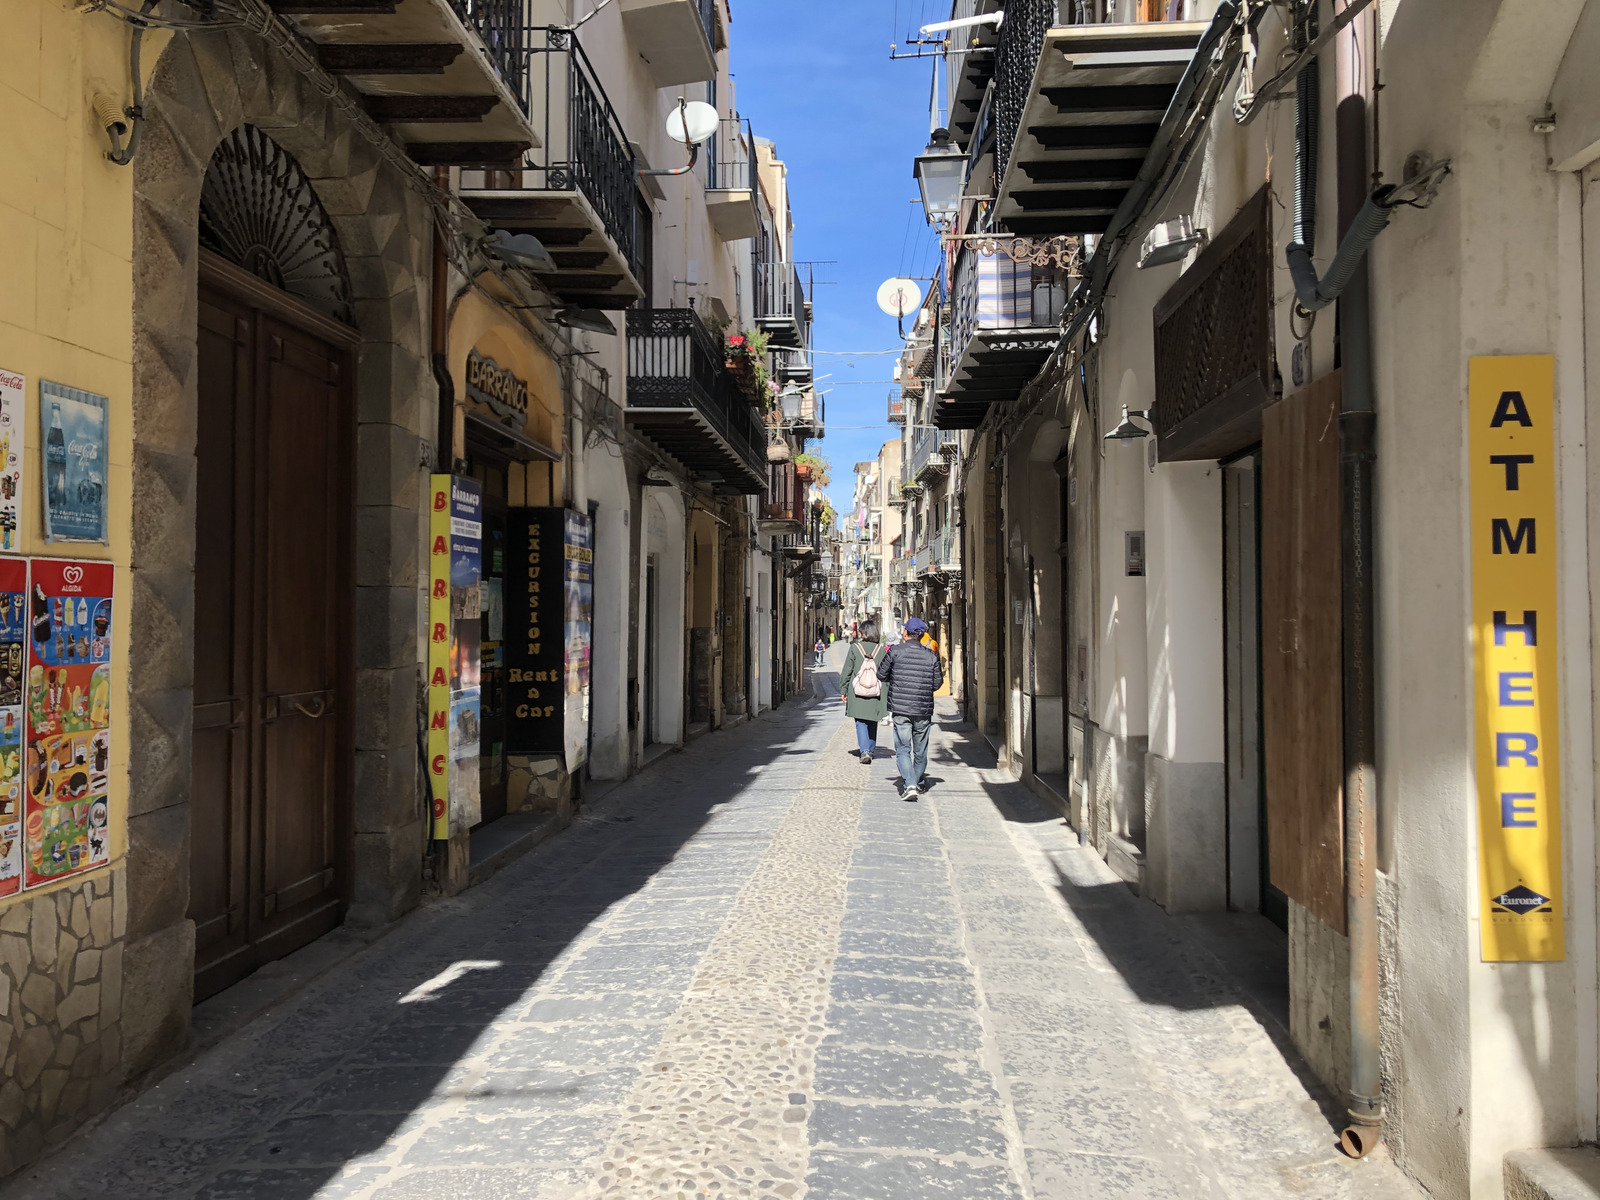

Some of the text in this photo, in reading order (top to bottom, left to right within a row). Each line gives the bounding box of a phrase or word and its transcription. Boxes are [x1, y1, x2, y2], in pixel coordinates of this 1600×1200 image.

[470, 355, 528, 414] BARRANCO
[452, 485, 480, 506] BARRANCO
[527, 524, 541, 655] EXCURSION
[1489, 391, 1539, 828] ATM HERE
[431, 491, 448, 819] BARRANCO
[508, 668, 559, 683] Rent
[527, 687, 540, 699] a
[515, 704, 555, 718] Car
[1500, 894, 1543, 905] Euronet
